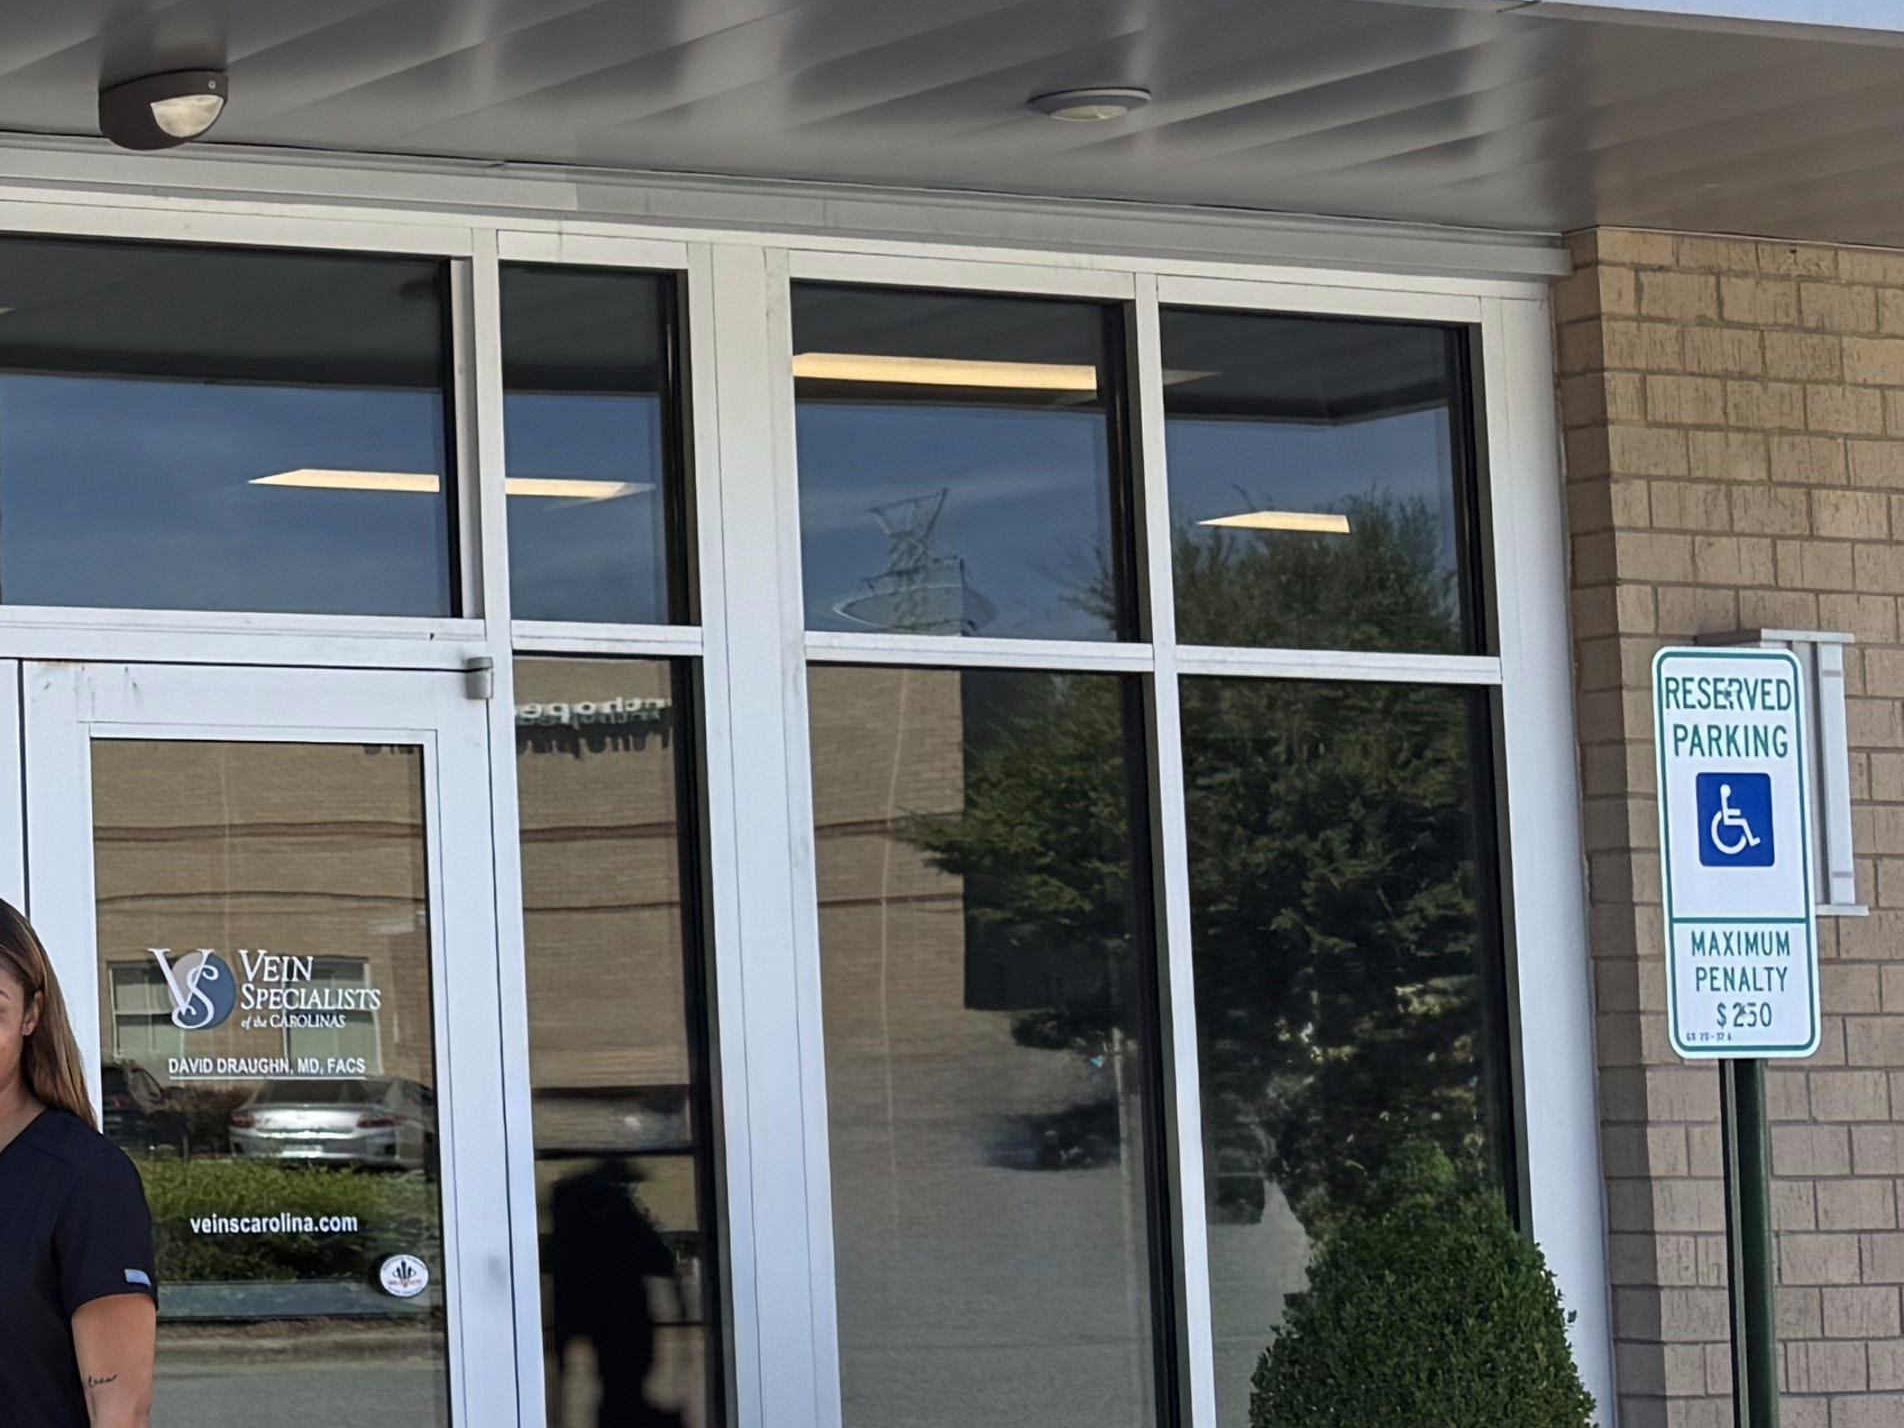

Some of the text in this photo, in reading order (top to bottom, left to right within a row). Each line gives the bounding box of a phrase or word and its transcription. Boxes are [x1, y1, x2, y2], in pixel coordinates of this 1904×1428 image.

[1664, 676, 1792, 711] RESERVED
[1673, 723, 1789, 758] PARKING
[1691, 931, 1791, 957] MAXIMUM
[238, 949, 314, 982] VEIN
[1695, 966, 1788, 992] PENALTY
[240, 983, 382, 1011] SPECIALISTS
[241, 1016, 251, 1030] of
[269, 1014, 347, 1029] CAROLINAS
[1716, 1002, 1773, 1028] $250
[168, 1057, 366, 1075] DAVID DRAUGHN, MD, FACS
[190, 1212, 358, 1235] veinscarolina.com
